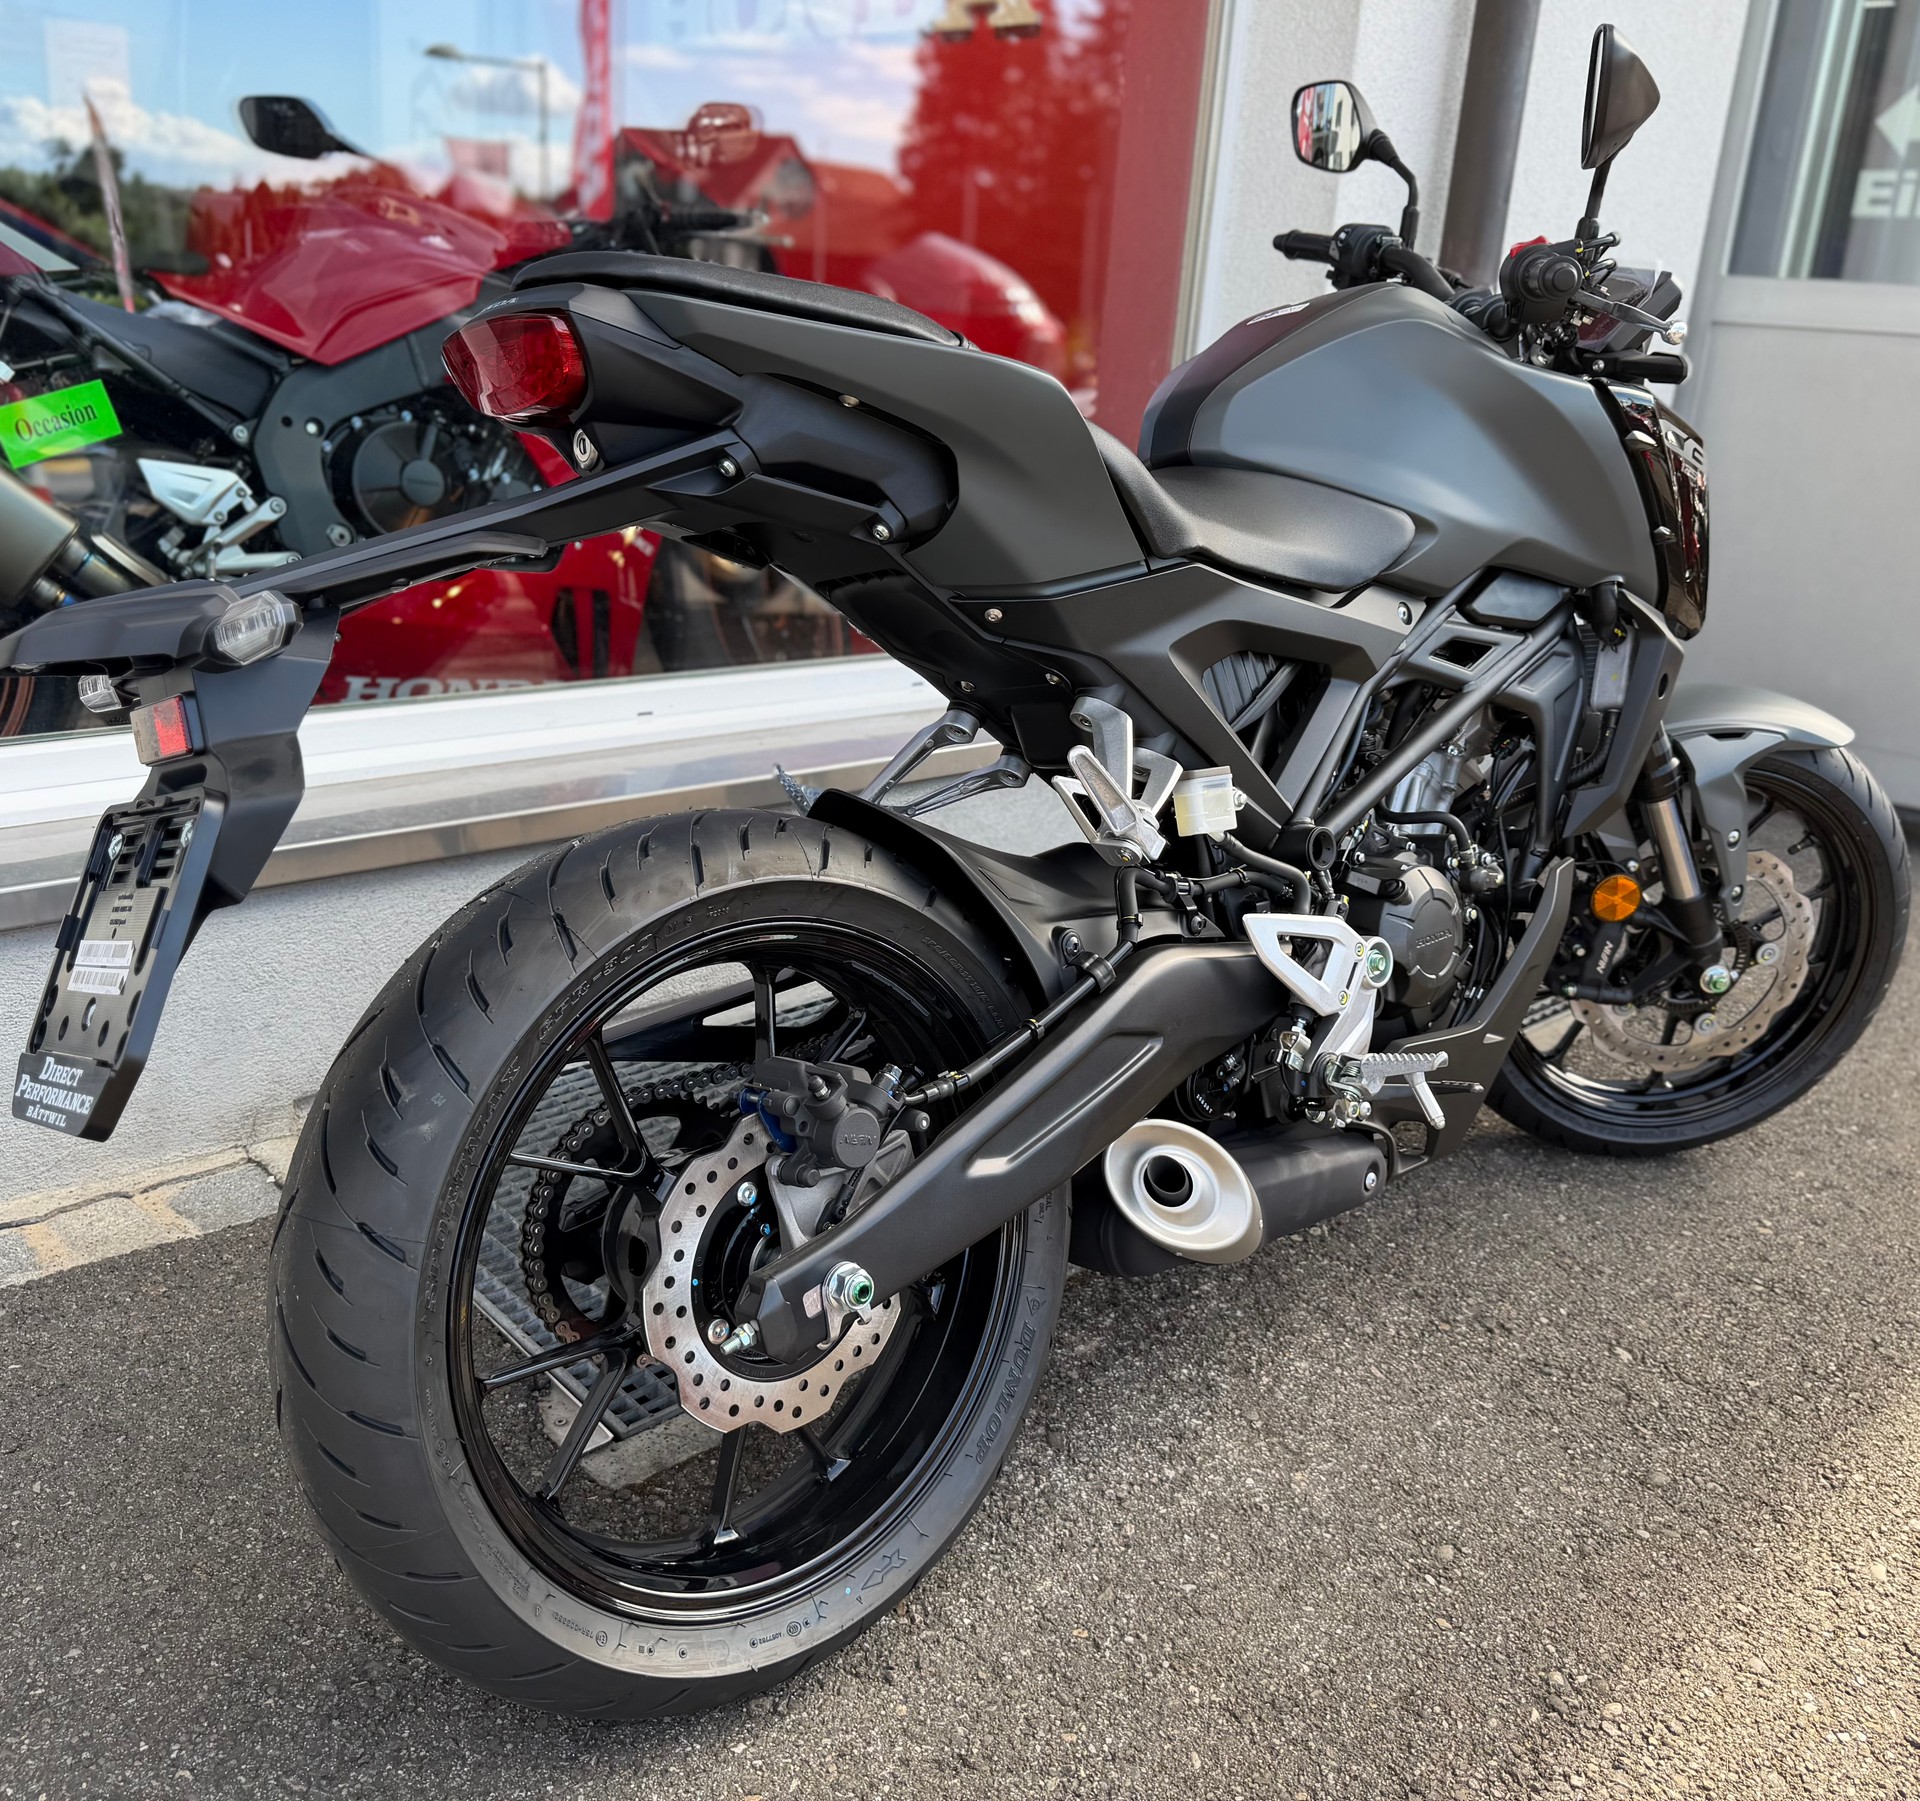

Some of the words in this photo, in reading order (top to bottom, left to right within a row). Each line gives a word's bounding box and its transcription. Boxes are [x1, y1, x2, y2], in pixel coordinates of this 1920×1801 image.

[1850, 168, 1920, 218] Ei
[15, 404, 97, 441] Occasion
[39, 1056, 83, 1087] DIRECT
[15, 1073, 94, 1115] PERFORMANCE
[26, 1104, 67, 1127] BÄTTWIL
[975, 1320, 1038, 1466] DUNLOP
